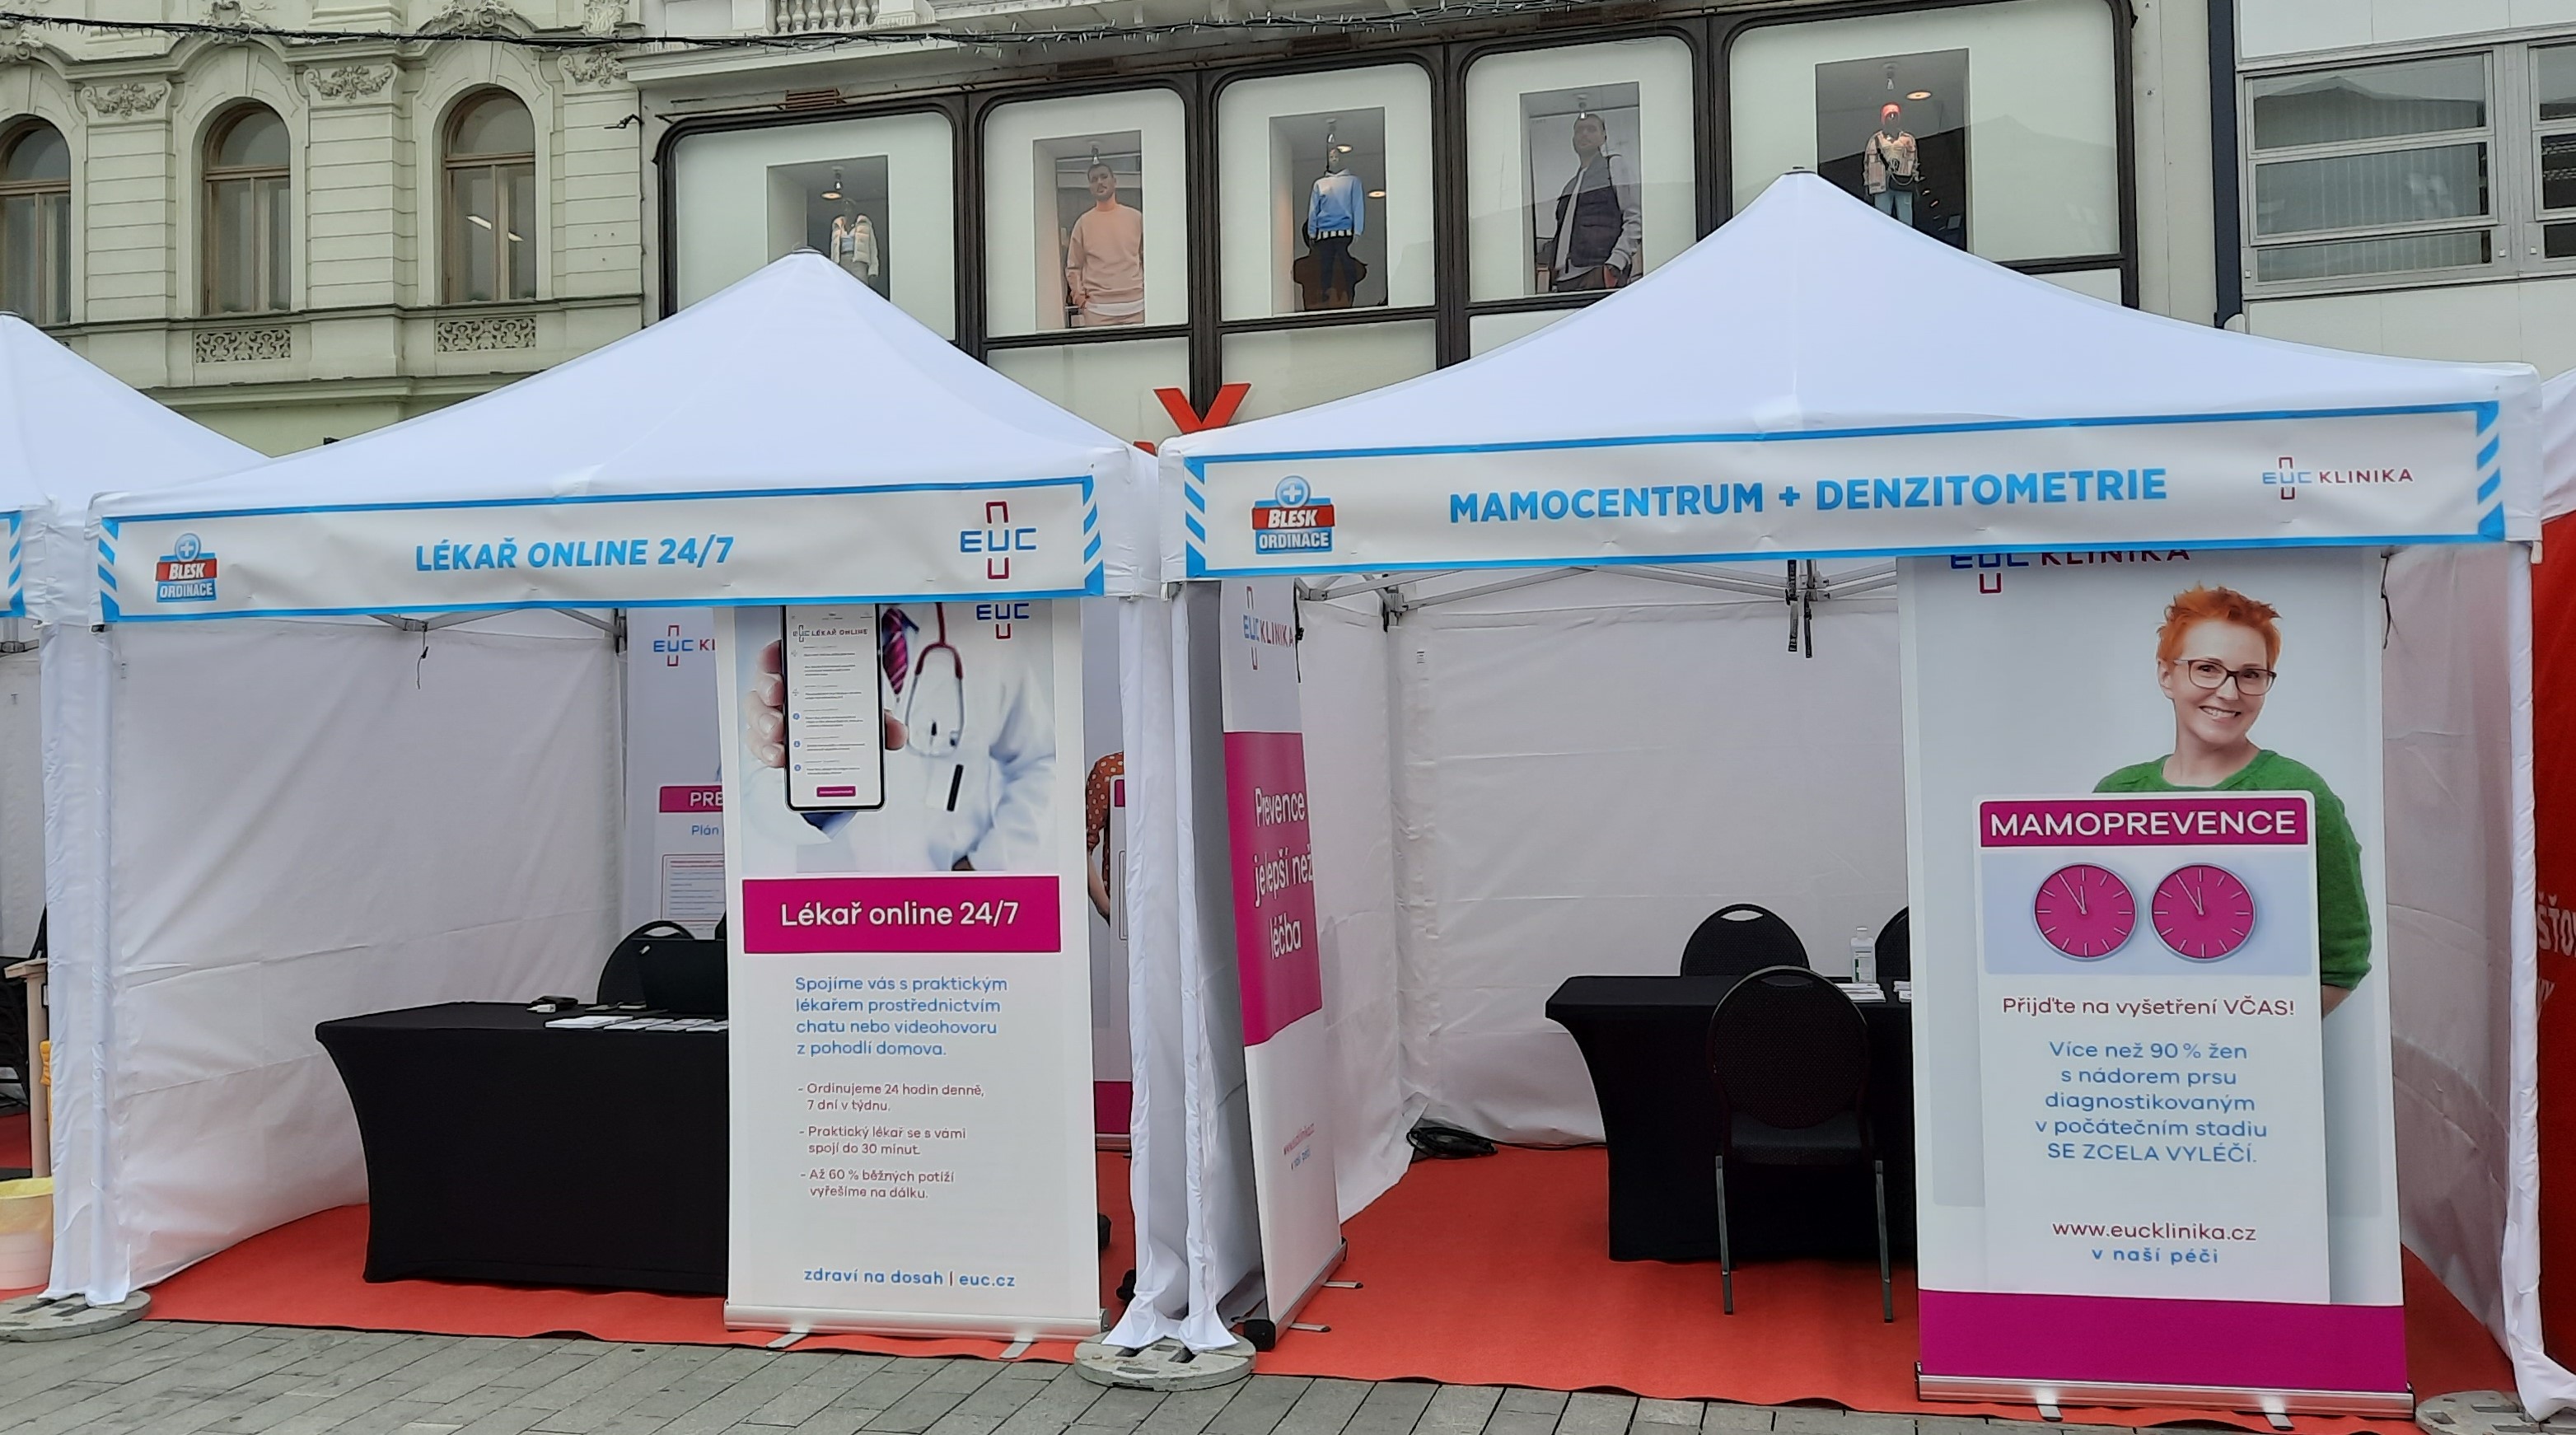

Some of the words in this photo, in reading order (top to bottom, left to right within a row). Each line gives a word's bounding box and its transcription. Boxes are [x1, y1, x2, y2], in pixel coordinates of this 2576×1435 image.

[2320, 469, 2413, 483] KLINIKA
[1451, 483, 1763, 523] MAMOCENTRUM
[1817, 469, 2167, 511] DENZITOMETRIE
[1267, 509, 1318, 528] BLESK
[1259, 531, 1329, 549] ORDINACE
[417, 538, 517, 571] LÉKAŘ
[528, 540, 648, 568] ONLINE
[658, 535, 733, 568] 24/7
[168, 561, 206, 580] BLESK
[159, 582, 213, 597] ORDINACE
[1255, 788, 1305, 827] Prevence
[692, 825, 718, 835] Plán
[1992, 811, 2295, 835] MAMOPREVENCE
[782, 901, 862, 925] Lékař
[870, 902, 952, 924] online
[961, 900, 1018, 926] 24/7
[1269, 912, 1302, 960] léčba
[796, 977, 863, 993] Spojíme
[868, 977, 895, 989] vás
[900, 980, 907, 989] s
[913, 976, 1007, 993] praktickým
[797, 998, 863, 1012] lékařem
[869, 998, 1000, 1013] prostřednictvím
[2004, 998, 2075, 1017] Přijďte
[2083, 1003, 2108, 1013] na
[2116, 999, 2217, 1017] vyšetření
[2223, 996, 2293, 1015] VČAS!
[797, 1020, 844, 1033] chatu
[851, 1019, 890, 1033] nebo
[895, 1020, 996, 1033] videohovoru
[797, 1045, 805, 1054] z
[811, 1040, 872, 1057] pohodlí
[877, 1041, 946, 1055] domova.
[2050, 1041, 2097, 1057] Více
[2106, 1043, 2143, 1058] než
[2151, 1043, 2177, 1058] 90
[2183, 1043, 2200, 1058] %
[2209, 1043, 2246, 1059] žen
[2062, 1071, 2071, 1082] s
[2079, 1068, 2179, 1083] nádorem
[2188, 1073, 2236, 1087] prsu
[807, 1082, 881, 1096] Ordinujeme
[885, 1084, 898, 1094] 24
[903, 1083, 937, 1095] hodin
[808, 1100, 814, 1110] 7
[818, 1100, 838, 1110] dní
[2045, 1092, 2254, 1113] diagnostikovaným
[809, 1126, 869, 1139] Praktický
[873, 1126, 902, 1137] lékař
[935, 1128, 965, 1138] vámi
[2036, 1121, 2047, 1132] v
[2055, 1118, 2188, 1135] počátečním
[2196, 1121, 2266, 1137] stadiu
[809, 1143, 839, 1155] spojí
[843, 1143, 858, 1152] do
[863, 1143, 877, 1153] 30
[2049, 1143, 2074, 1158] SE
[2083, 1144, 2159, 1161] ZCELA
[2167, 1140, 2256, 1162] VYLÉČÍ.
[810, 1169, 825, 1179] Až
[830, 1169, 844, 1179] 60
[849, 1170, 858, 1180] %
[863, 1170, 914, 1183] běžných
[919, 1171, 953, 1184] potíží
[811, 1185, 866, 1197] vyřešíme
[2053, 1222, 2256, 1240] www.eucklinika.cz
[2092, 1250, 2102, 1260] v
[2114, 1248, 2160, 1261] naší
[2171, 1249, 2217, 1265] péči
[805, 1268, 858, 1282] zdraví
[865, 1273, 884, 1283] na
[891, 1270, 942, 1284] dosah
[960, 1276, 1014, 1286] euc.cz
